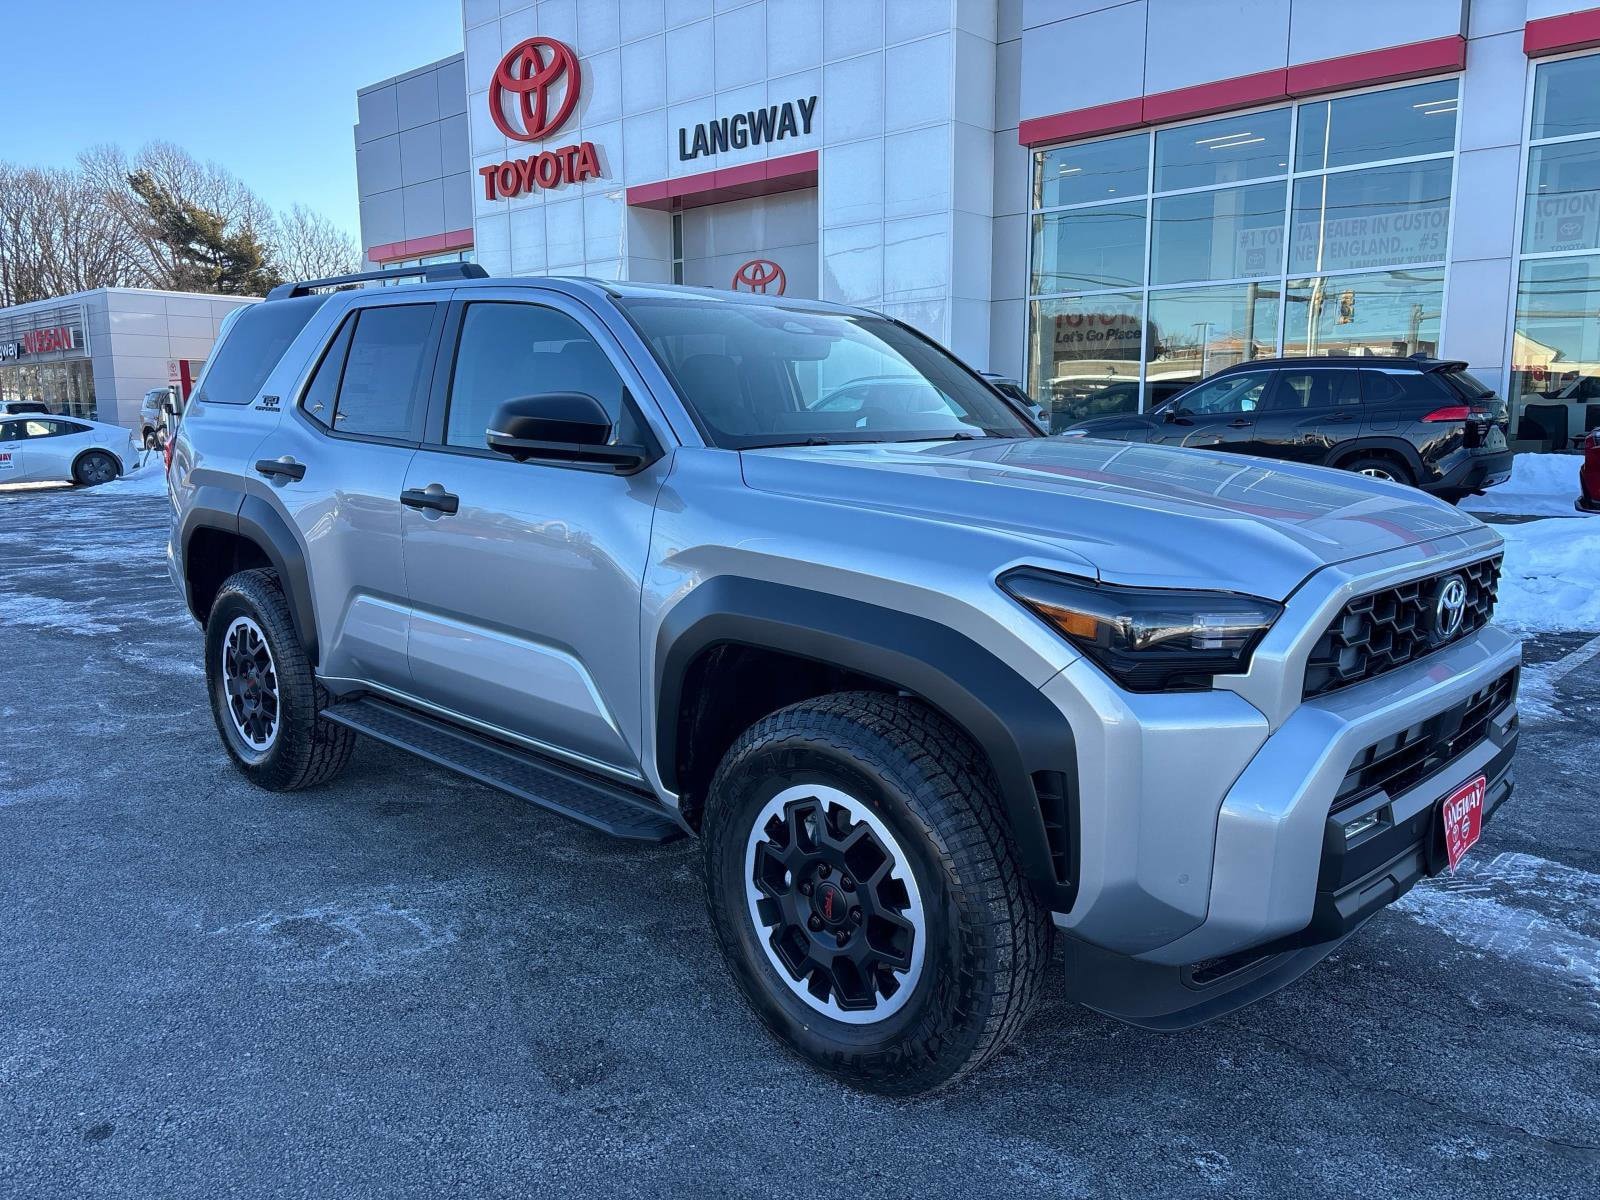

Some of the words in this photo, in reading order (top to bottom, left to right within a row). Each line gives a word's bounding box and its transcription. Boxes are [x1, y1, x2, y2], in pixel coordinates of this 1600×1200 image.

[678, 96, 817, 161] LANGWAY
[479, 142, 601, 200] TOYOTA
[1239, 232, 1255, 248] #1
[1372, 216, 1389, 234] IN
[1418, 232, 1440, 251] #5
[24, 327, 74, 354] NISSAN
[1055, 330, 1084, 344] Let's
[1086, 329, 1104, 342] Go
[1105, 327, 1142, 341] Place
